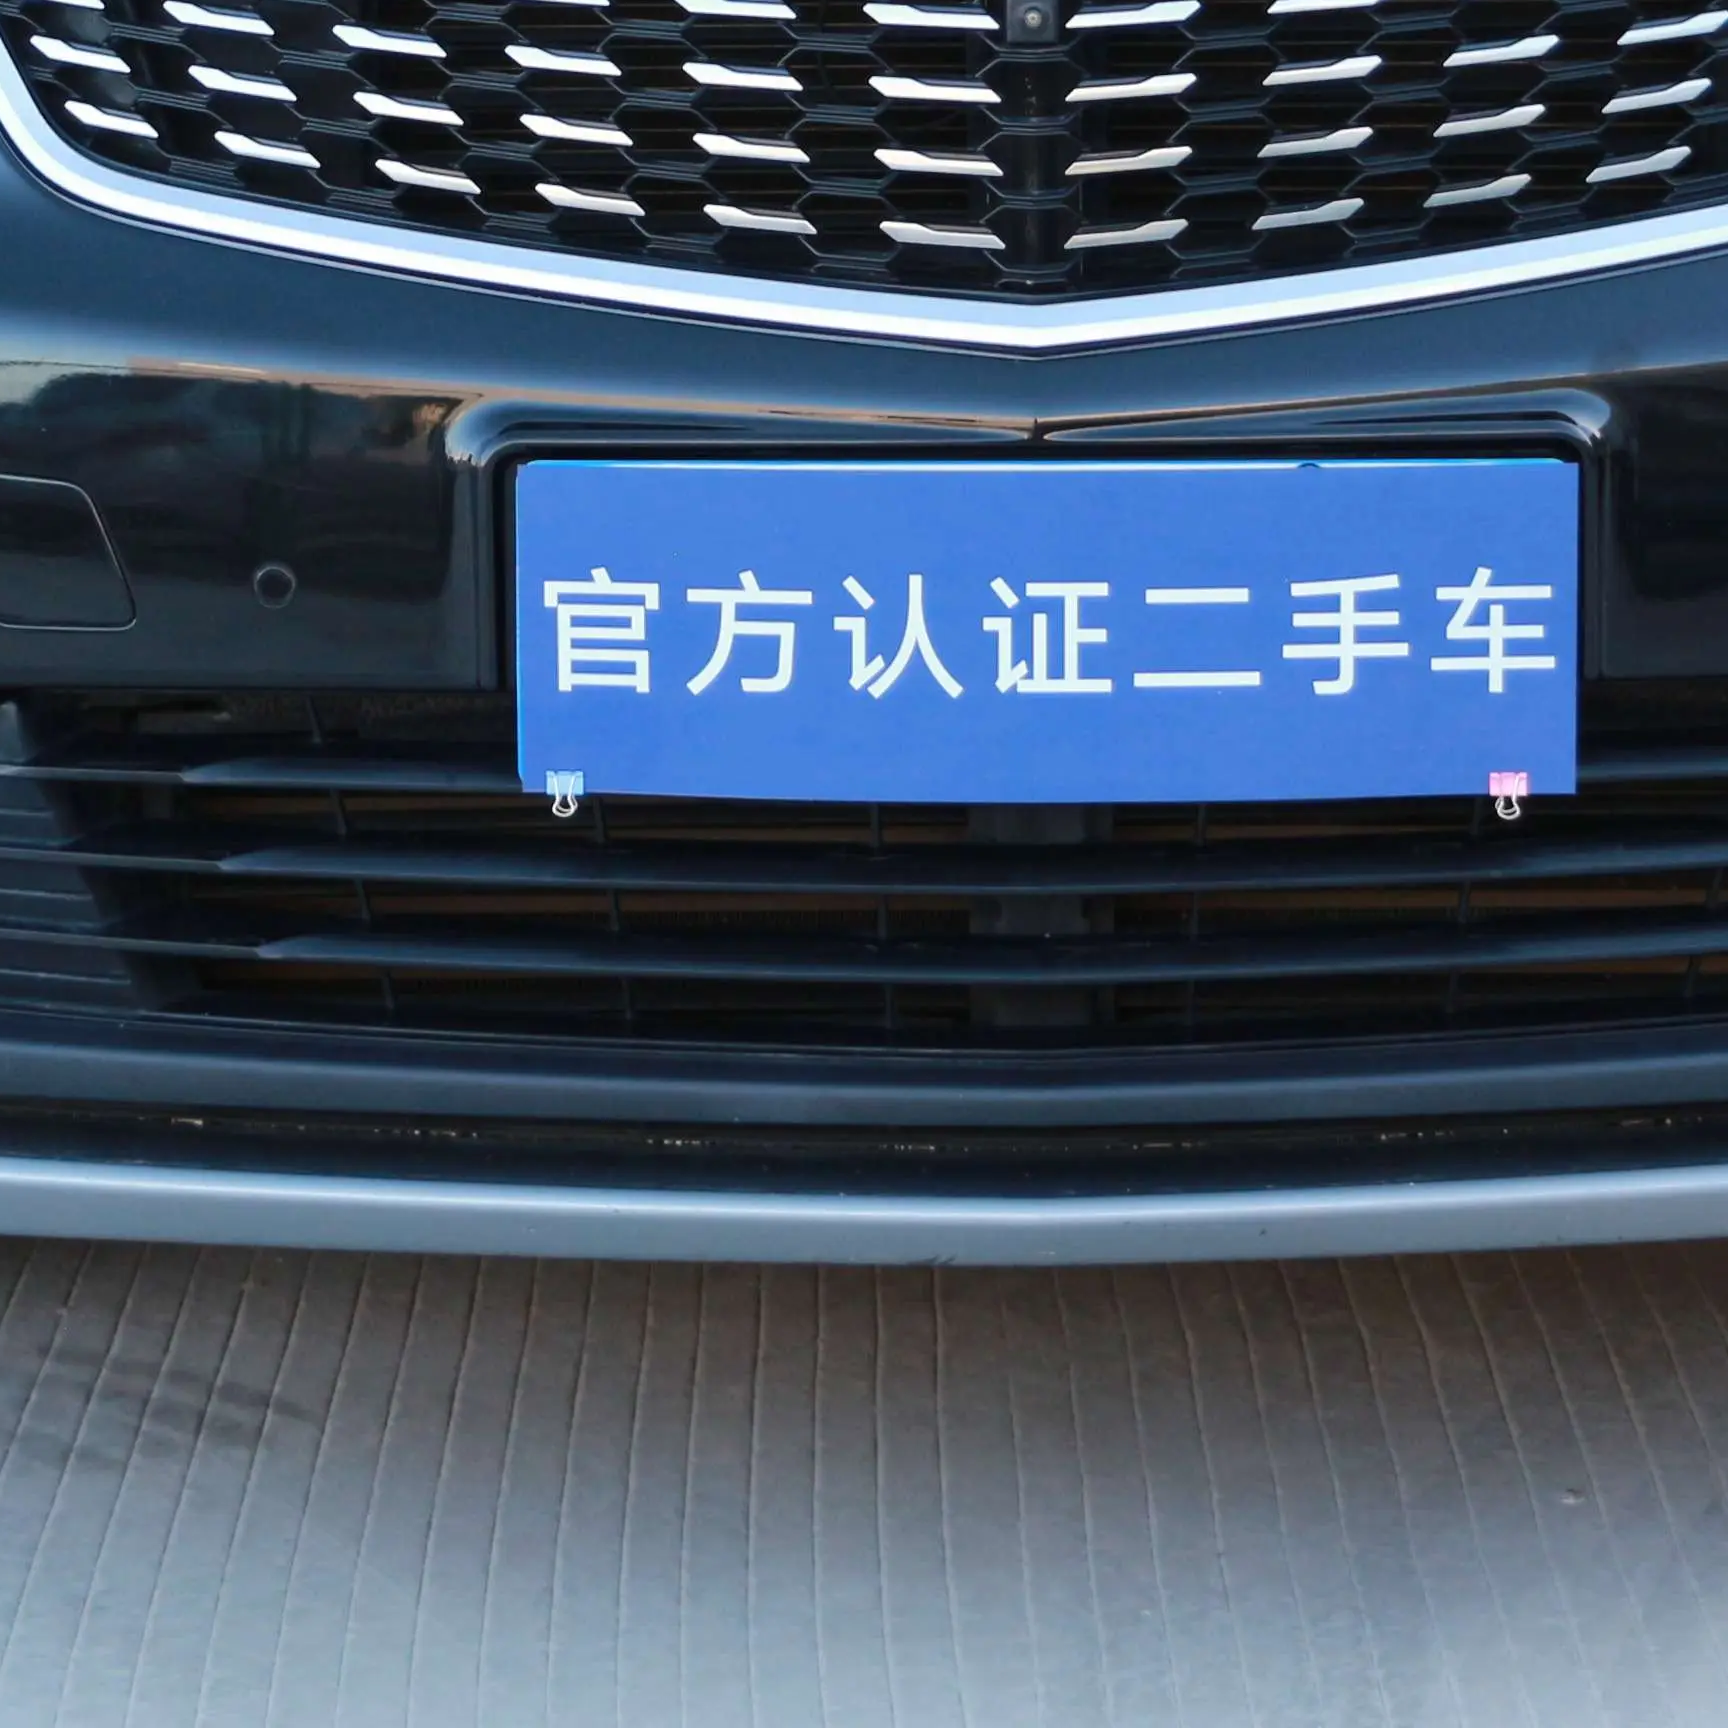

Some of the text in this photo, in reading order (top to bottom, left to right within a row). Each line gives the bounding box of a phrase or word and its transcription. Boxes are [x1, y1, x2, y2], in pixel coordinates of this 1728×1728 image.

[543, 565, 1557, 697] 官方认证二手车
